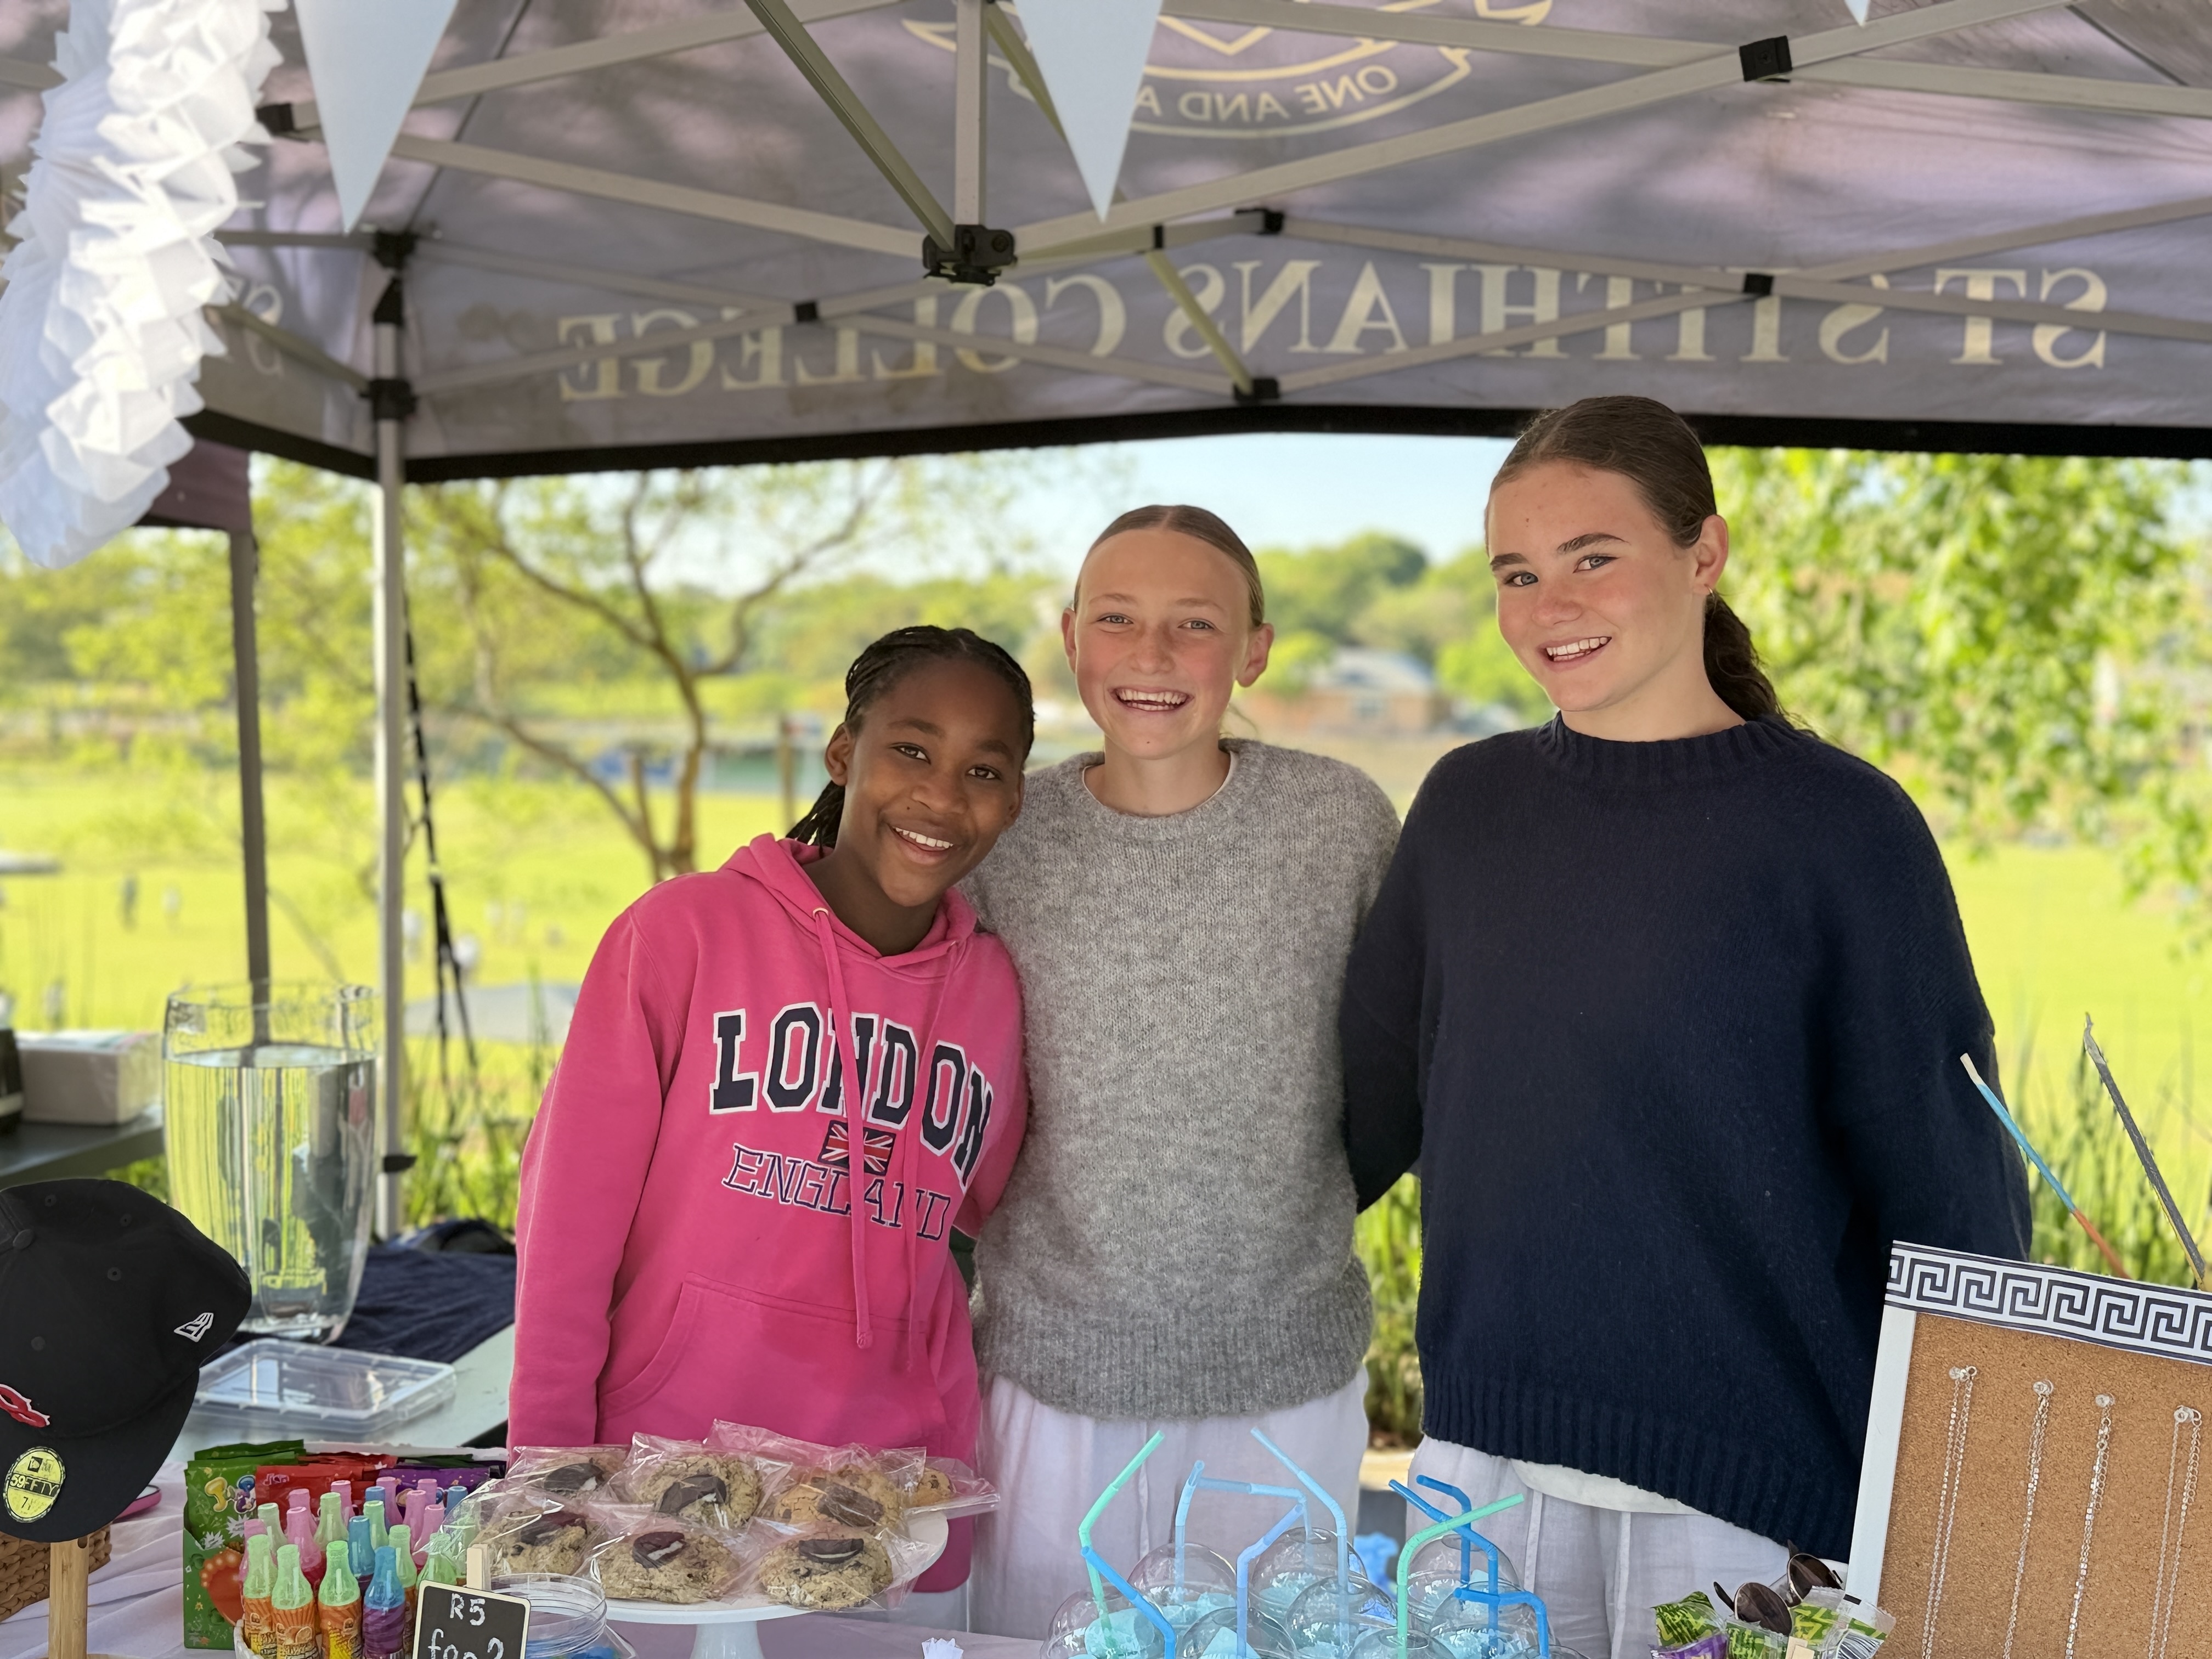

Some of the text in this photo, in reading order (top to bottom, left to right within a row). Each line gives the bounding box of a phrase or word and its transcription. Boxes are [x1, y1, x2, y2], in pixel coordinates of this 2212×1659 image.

[709, 1001, 994, 1194] LONDON
[721, 1142, 951, 1242] ENGLAND
[449, 1593, 486, 1626] R5
